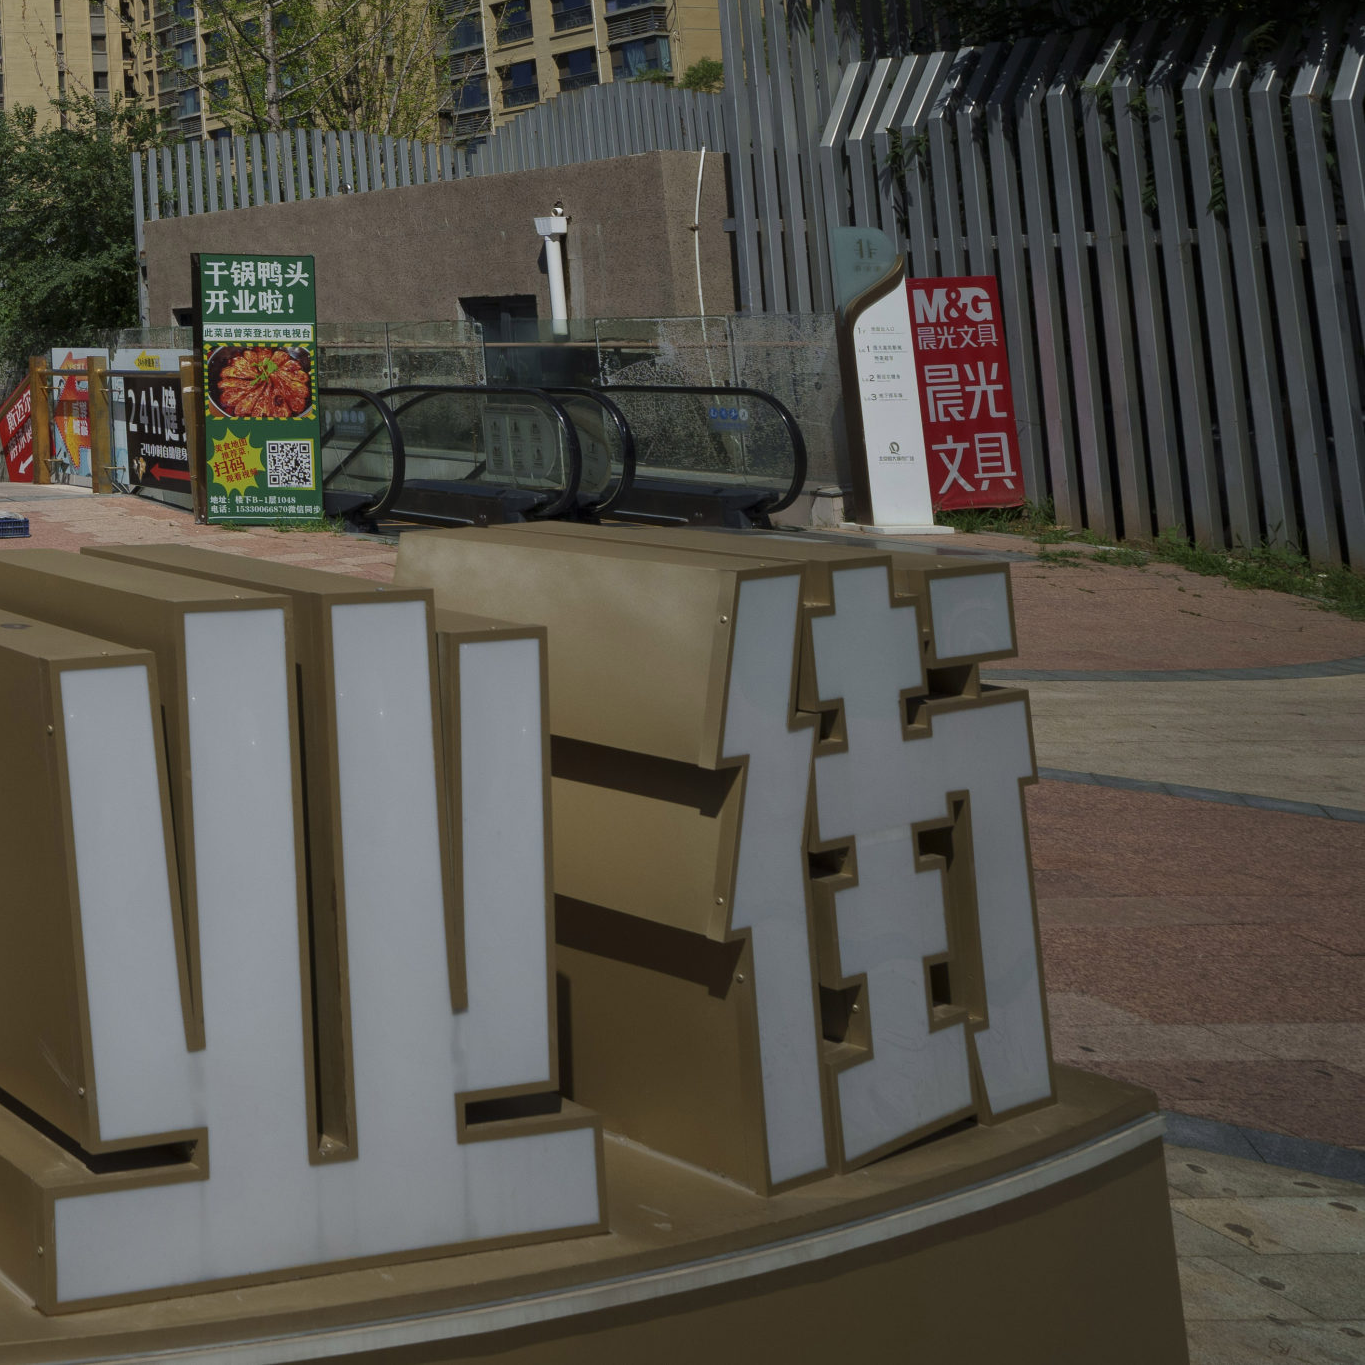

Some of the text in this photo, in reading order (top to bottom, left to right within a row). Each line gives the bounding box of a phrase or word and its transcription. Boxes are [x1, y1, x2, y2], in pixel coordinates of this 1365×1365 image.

[204, 261, 310, 287] 干锅鸭头
[912, 287, 993, 324] M&G
[204, 328, 311, 339] 此菜品曾荣登北京电视台
[917, 324, 999, 351] 晨光文具
[924, 361, 1008, 423] 晨光
[128, 386, 187, 442] 24h健
[215, 438, 248, 452] 美食地图
[213, 456, 246, 477] 扫码
[226, 467, 259, 483] 观看视频
[931, 432, 1017, 494] 文具
